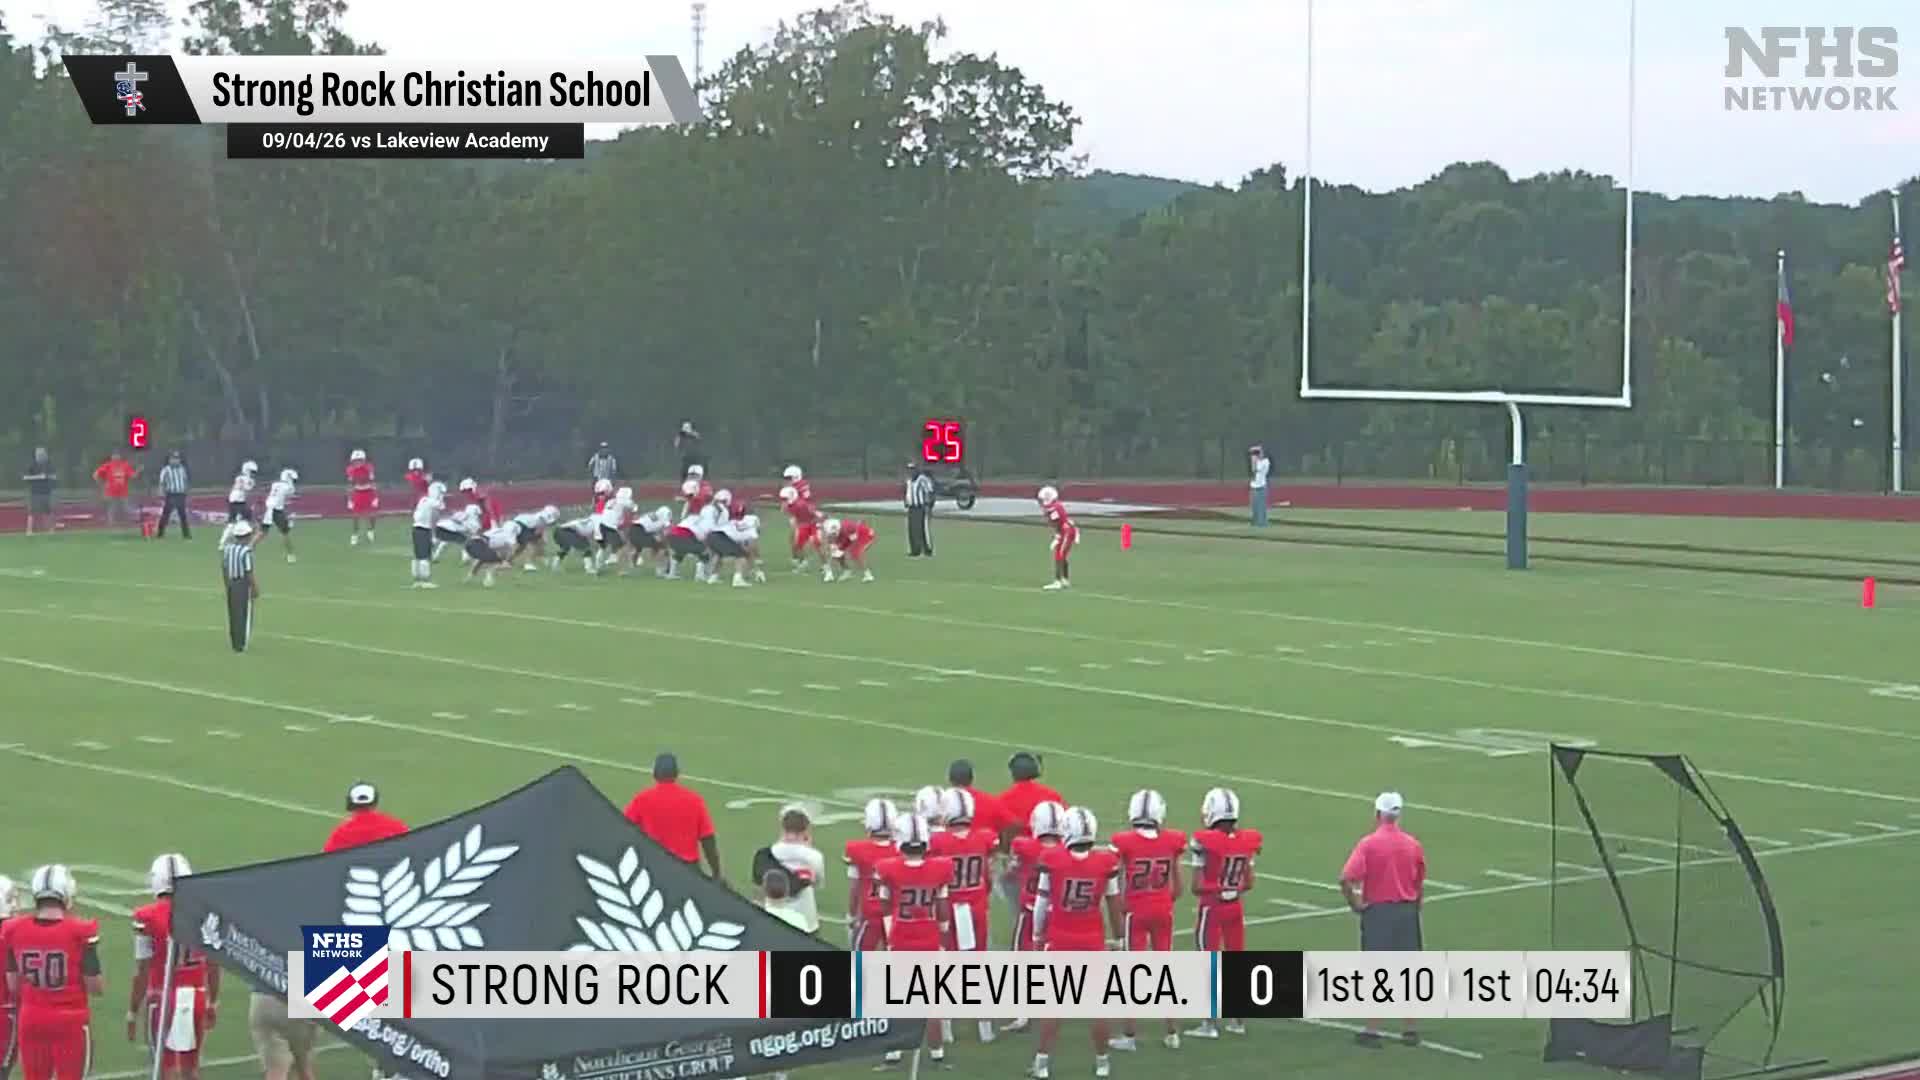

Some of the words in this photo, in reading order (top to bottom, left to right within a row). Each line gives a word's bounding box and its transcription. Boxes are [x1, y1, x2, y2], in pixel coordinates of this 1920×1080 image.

[131, 418, 148, 448] 2
[923, 420, 962, 462] 25
[1131, 858, 1172, 890] 23
[898, 887, 938, 920] 24
[1062, 879, 1094, 911] 15
[22, 951, 67, 990] 50
[750, 1018, 888, 1057] ngpg.org/ortho
